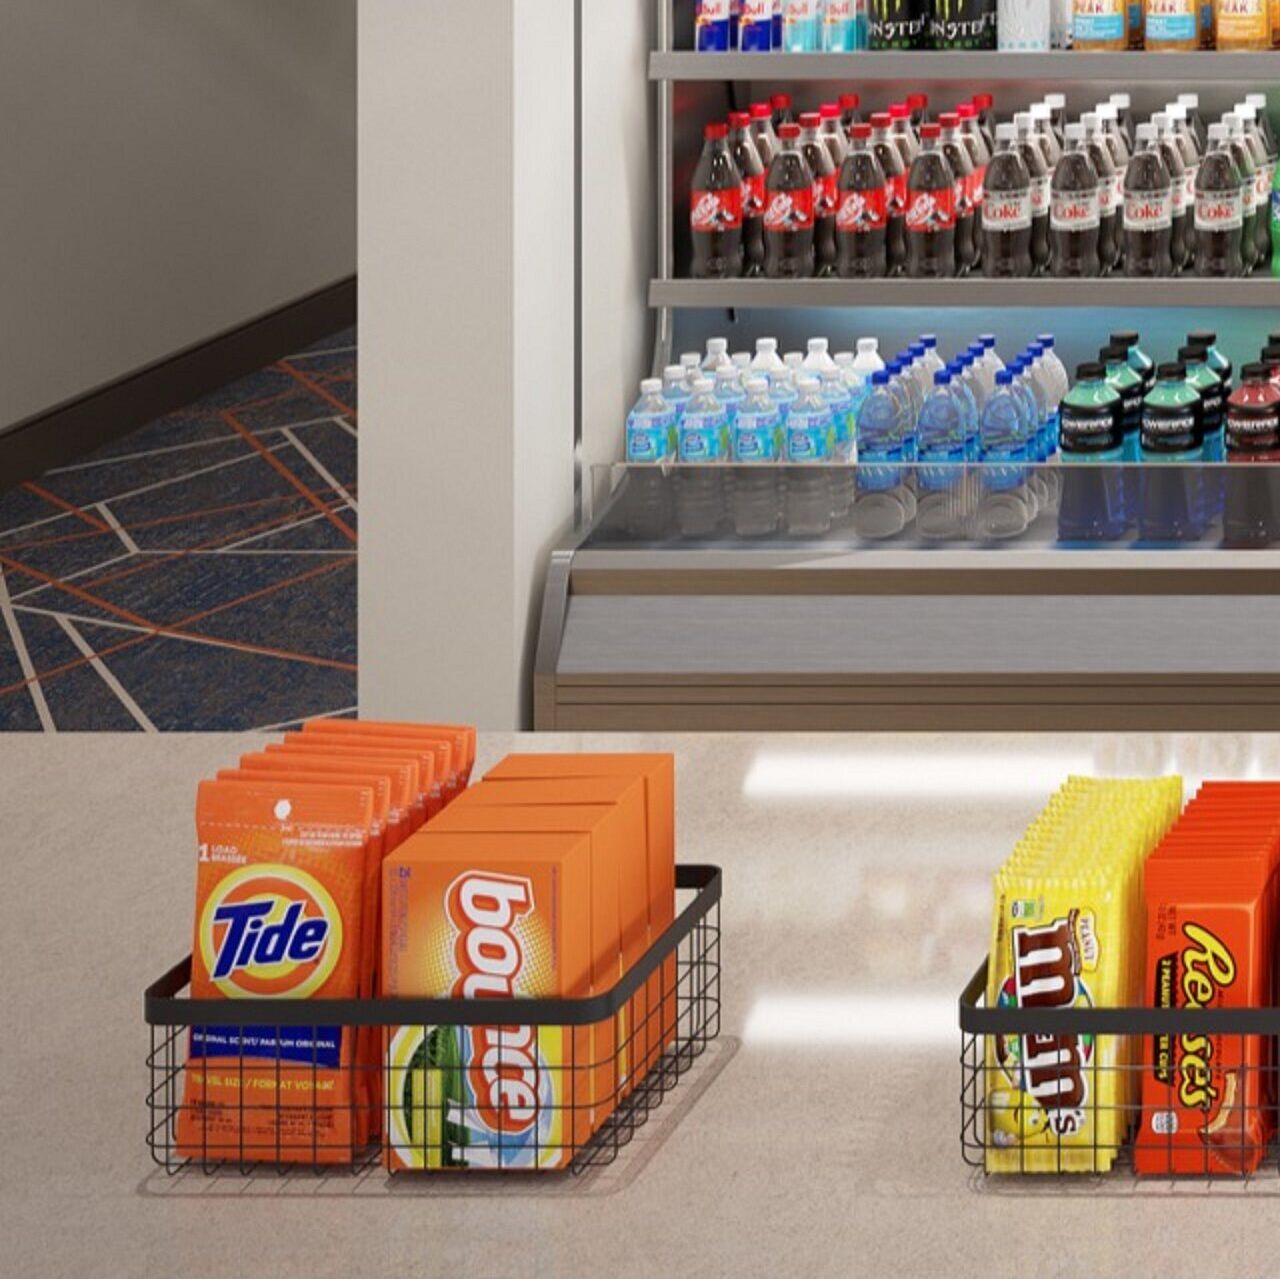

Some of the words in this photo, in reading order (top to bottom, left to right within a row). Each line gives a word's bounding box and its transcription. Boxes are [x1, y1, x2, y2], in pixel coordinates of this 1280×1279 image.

[984, 201, 1021, 219] Coke
[1054, 201, 1089, 219] Coke
[1126, 201, 1162, 219] Coke
[1199, 201, 1234, 219] Coke
[209, 900, 329, 983] Tide
[1081, 917, 1096, 962] PEANUT
[459, 877, 538, 1122] bounce
[1013, 920, 1086, 1135] mm's
[1179, 923, 1236, 1109] Rese's
[253, 1078, 292, 1090] FORAT
